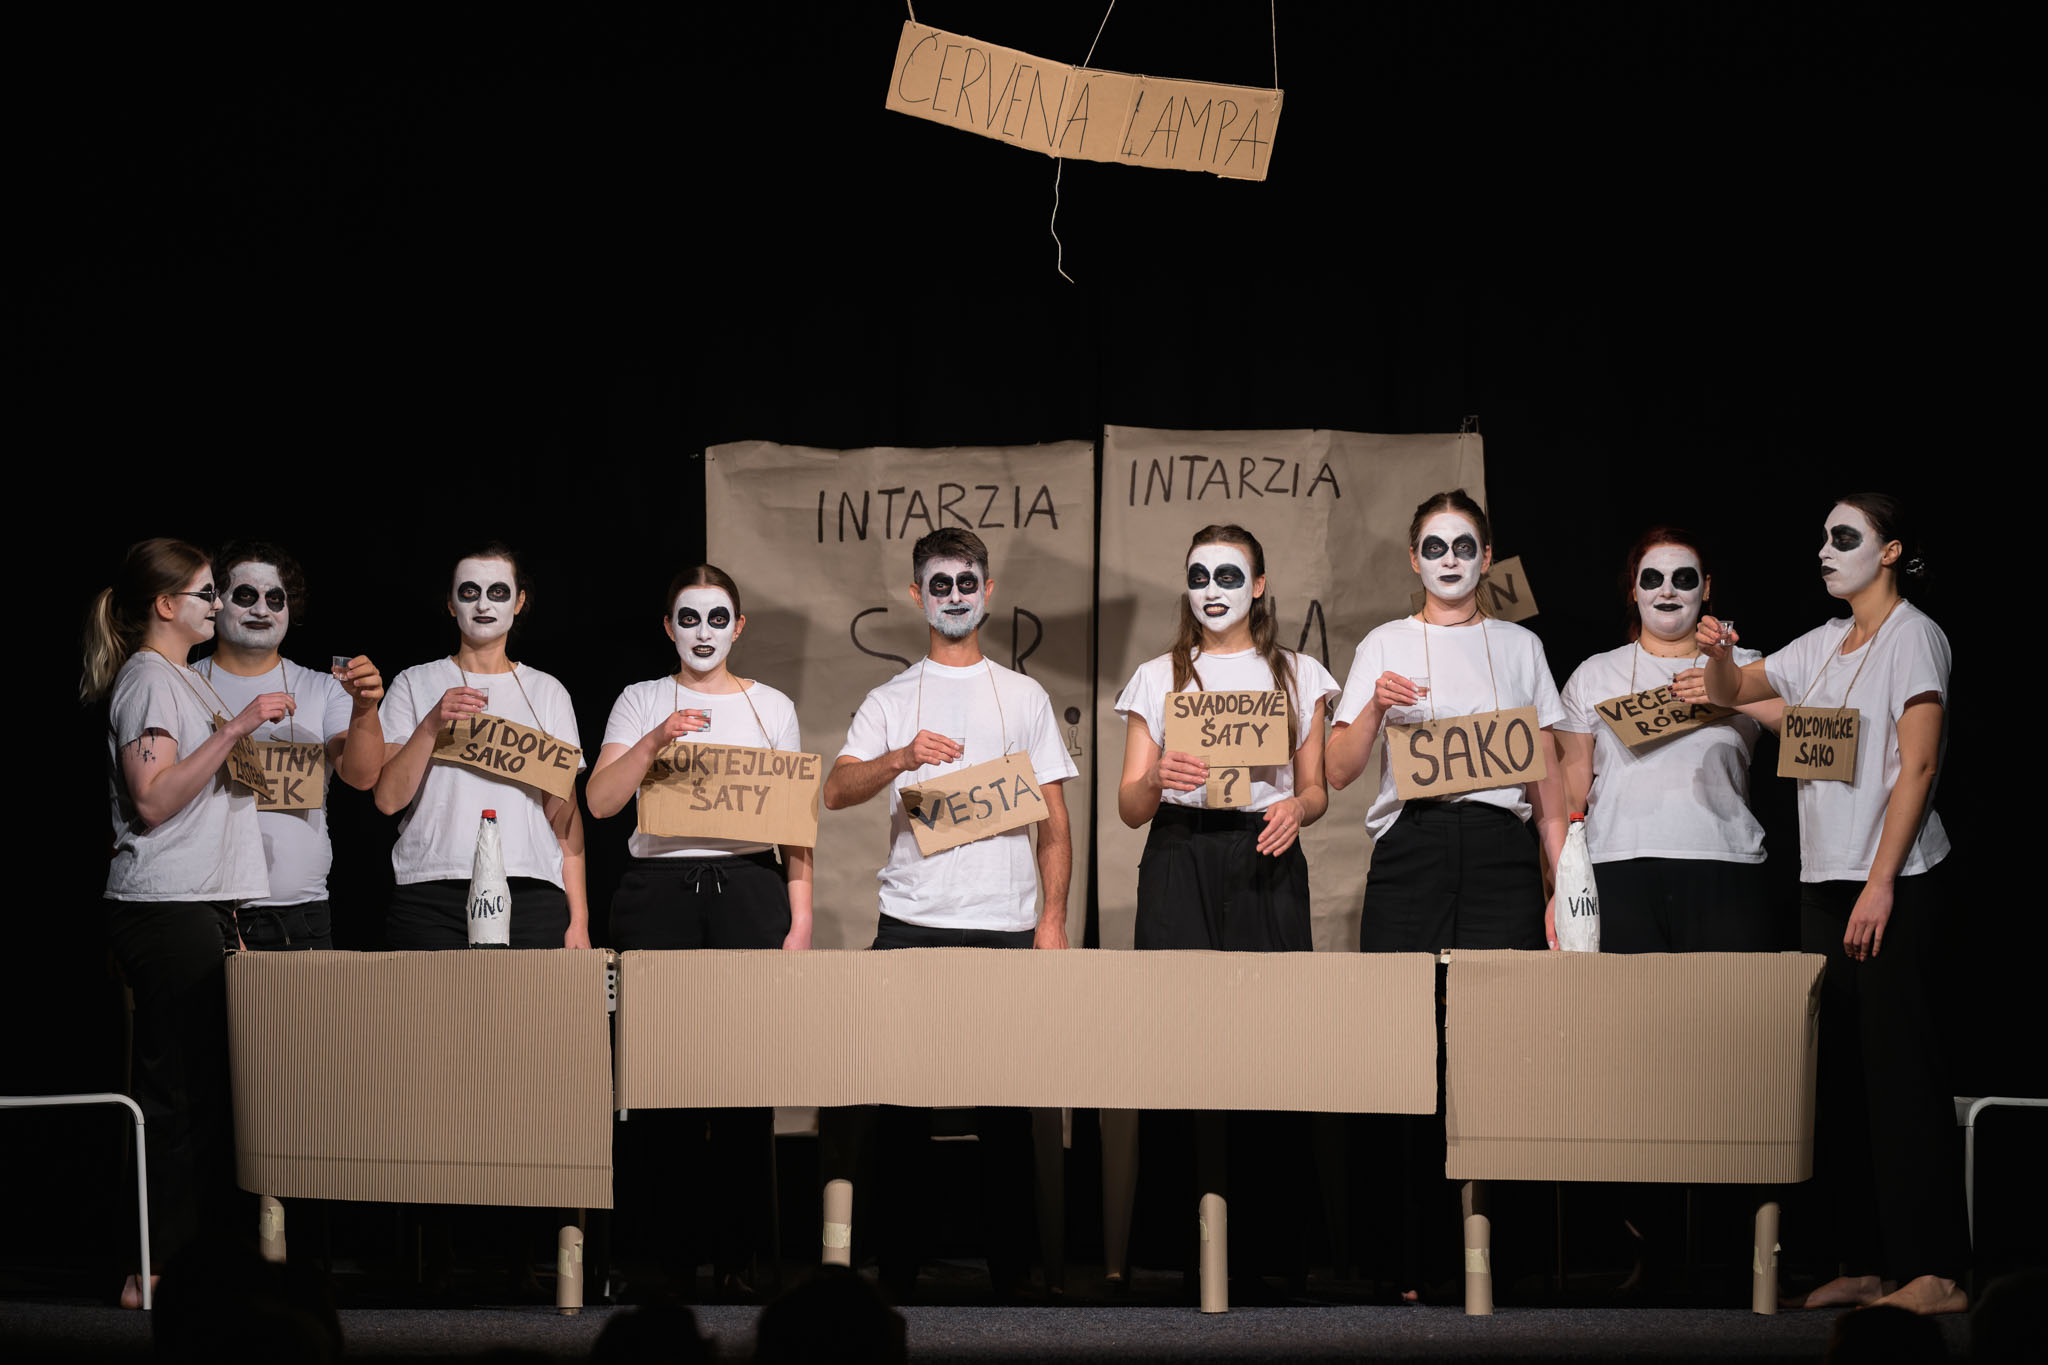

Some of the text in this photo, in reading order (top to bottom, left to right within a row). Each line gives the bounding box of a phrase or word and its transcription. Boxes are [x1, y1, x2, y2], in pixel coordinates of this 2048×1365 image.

[898, 32, 1104, 153] ČERVENÁ
[1129, 455, 1341, 506] INTARZIA
[818, 483, 1059, 543] INTARZIA
[1174, 692, 1286, 719] SVADOBNÉ
[1599, 688, 1673, 722] VEČE
[1635, 703, 1713, 736] RÓBA
[1200, 717, 1270, 748] ŠATY
[257, 743, 323, 777] ITNÝ
[459, 742, 526, 774] SAKO
[653, 744, 818, 780] KOKTEJLOVÉ
[1410, 718, 1535, 786] SAKO
[1794, 742, 1834, 768] SAKO
[689, 777, 771, 815] ŠATY
[1219, 768, 1240, 803] ?
[911, 774, 1042, 832] VESTA
[470, 890, 504, 920] VÍNO
